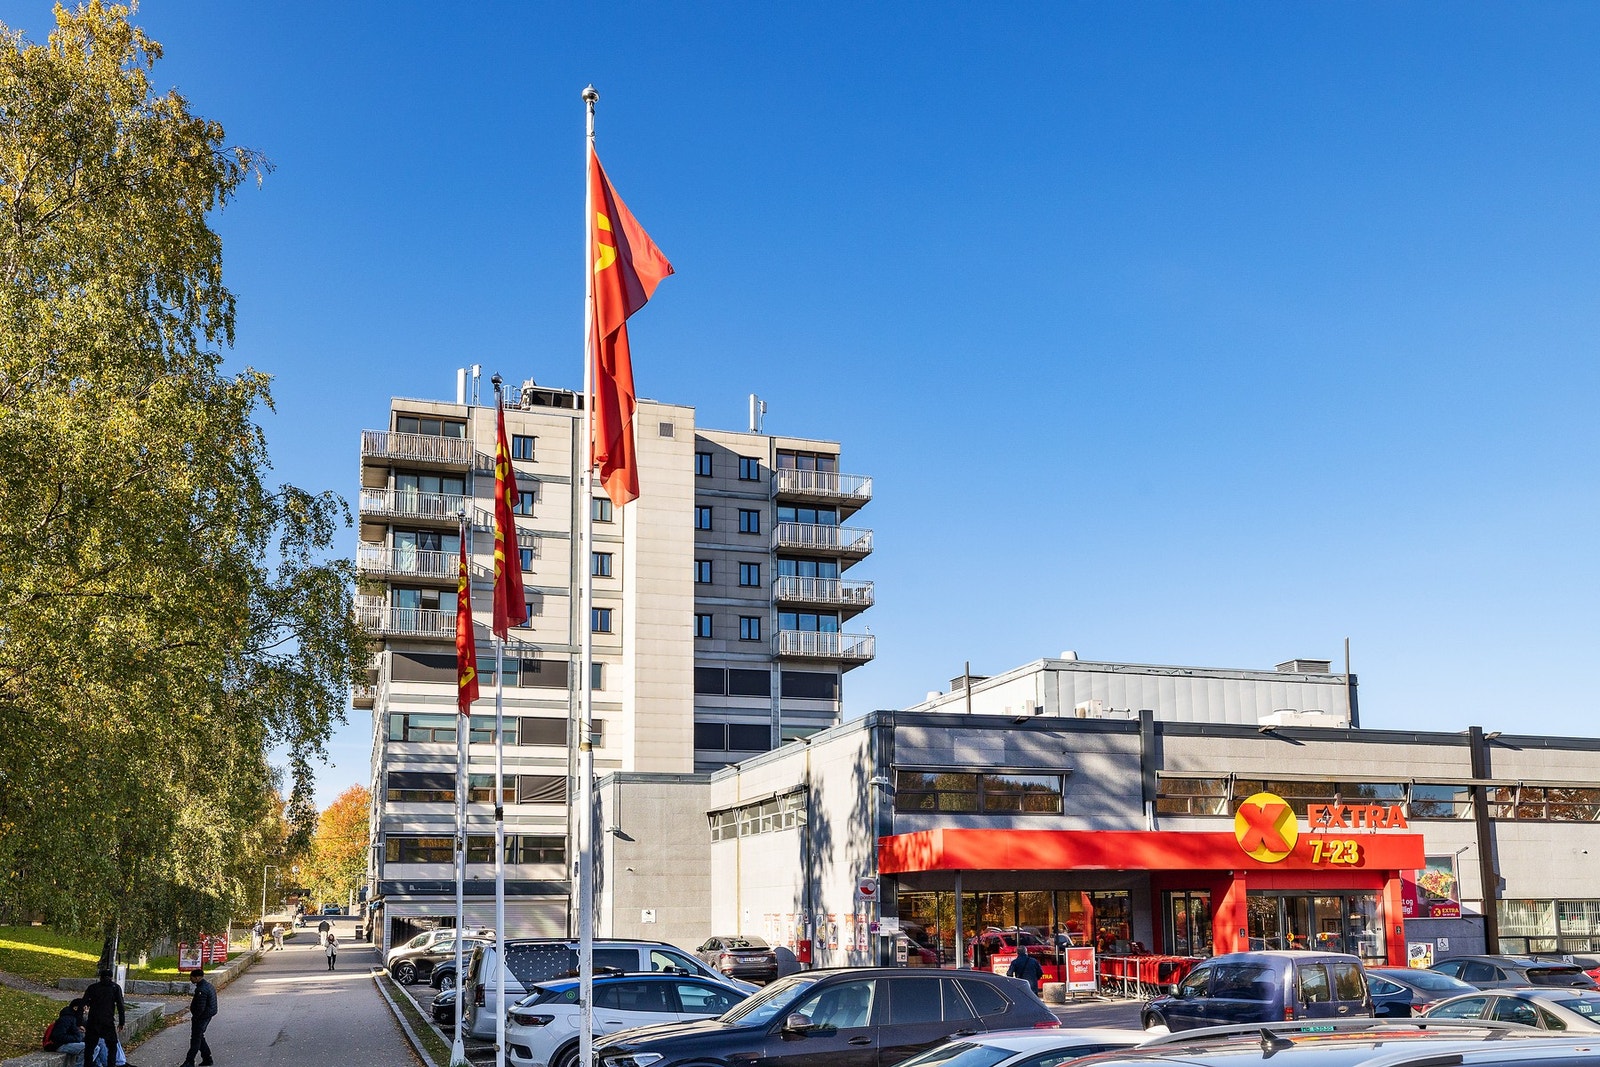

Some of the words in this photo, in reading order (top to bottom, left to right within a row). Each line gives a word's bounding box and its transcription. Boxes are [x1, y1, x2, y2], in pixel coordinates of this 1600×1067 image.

[1307, 803, 1408, 829] EXTRA
[1309, 839, 1360, 865] 7-23
[1073, 965, 1088, 973] billig!
